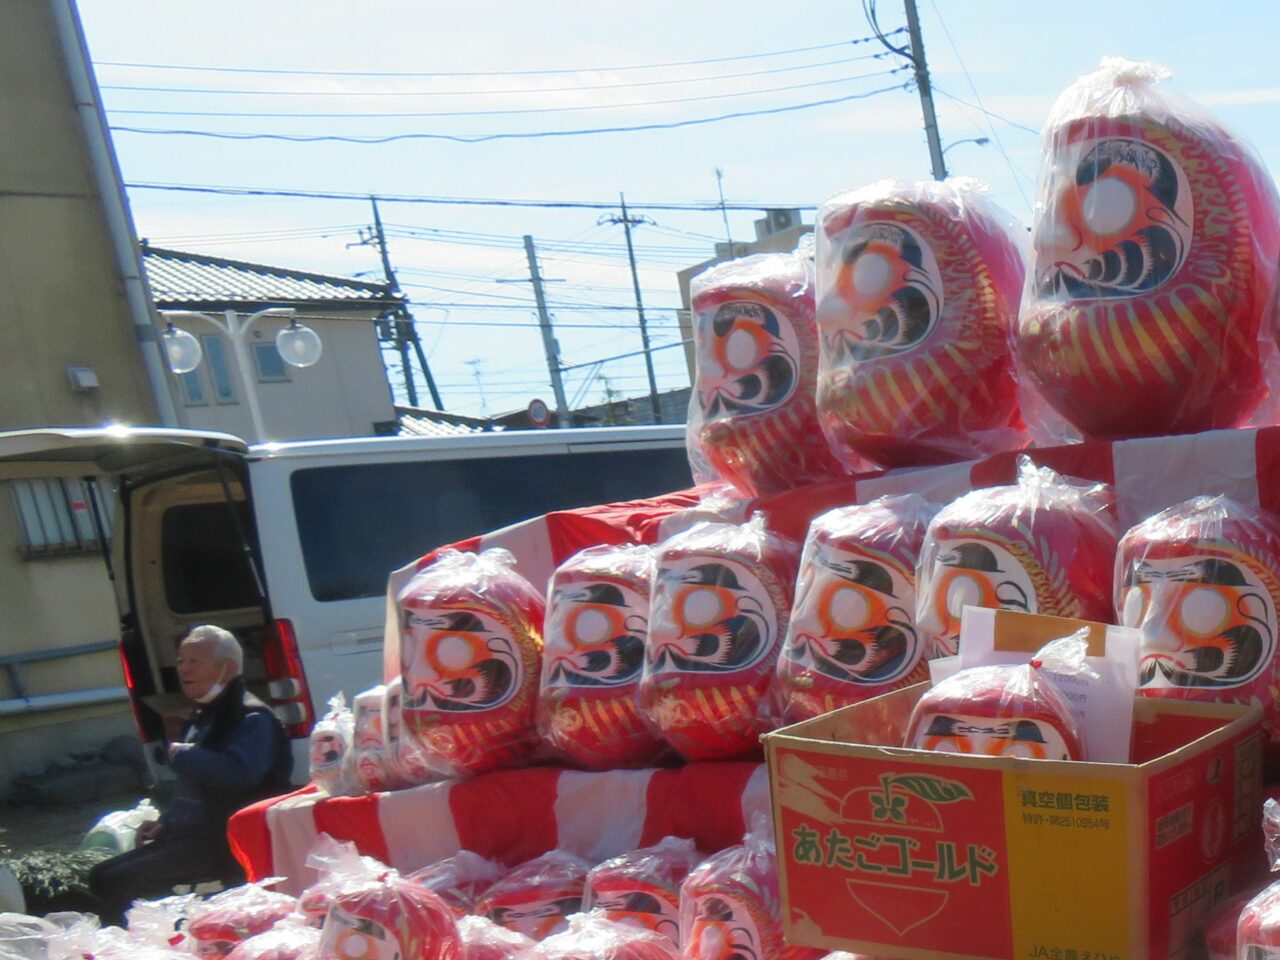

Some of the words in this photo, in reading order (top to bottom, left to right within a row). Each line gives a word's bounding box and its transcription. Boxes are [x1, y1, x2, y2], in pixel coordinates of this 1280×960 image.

[792, 823, 1000, 887] あたごゴールド
